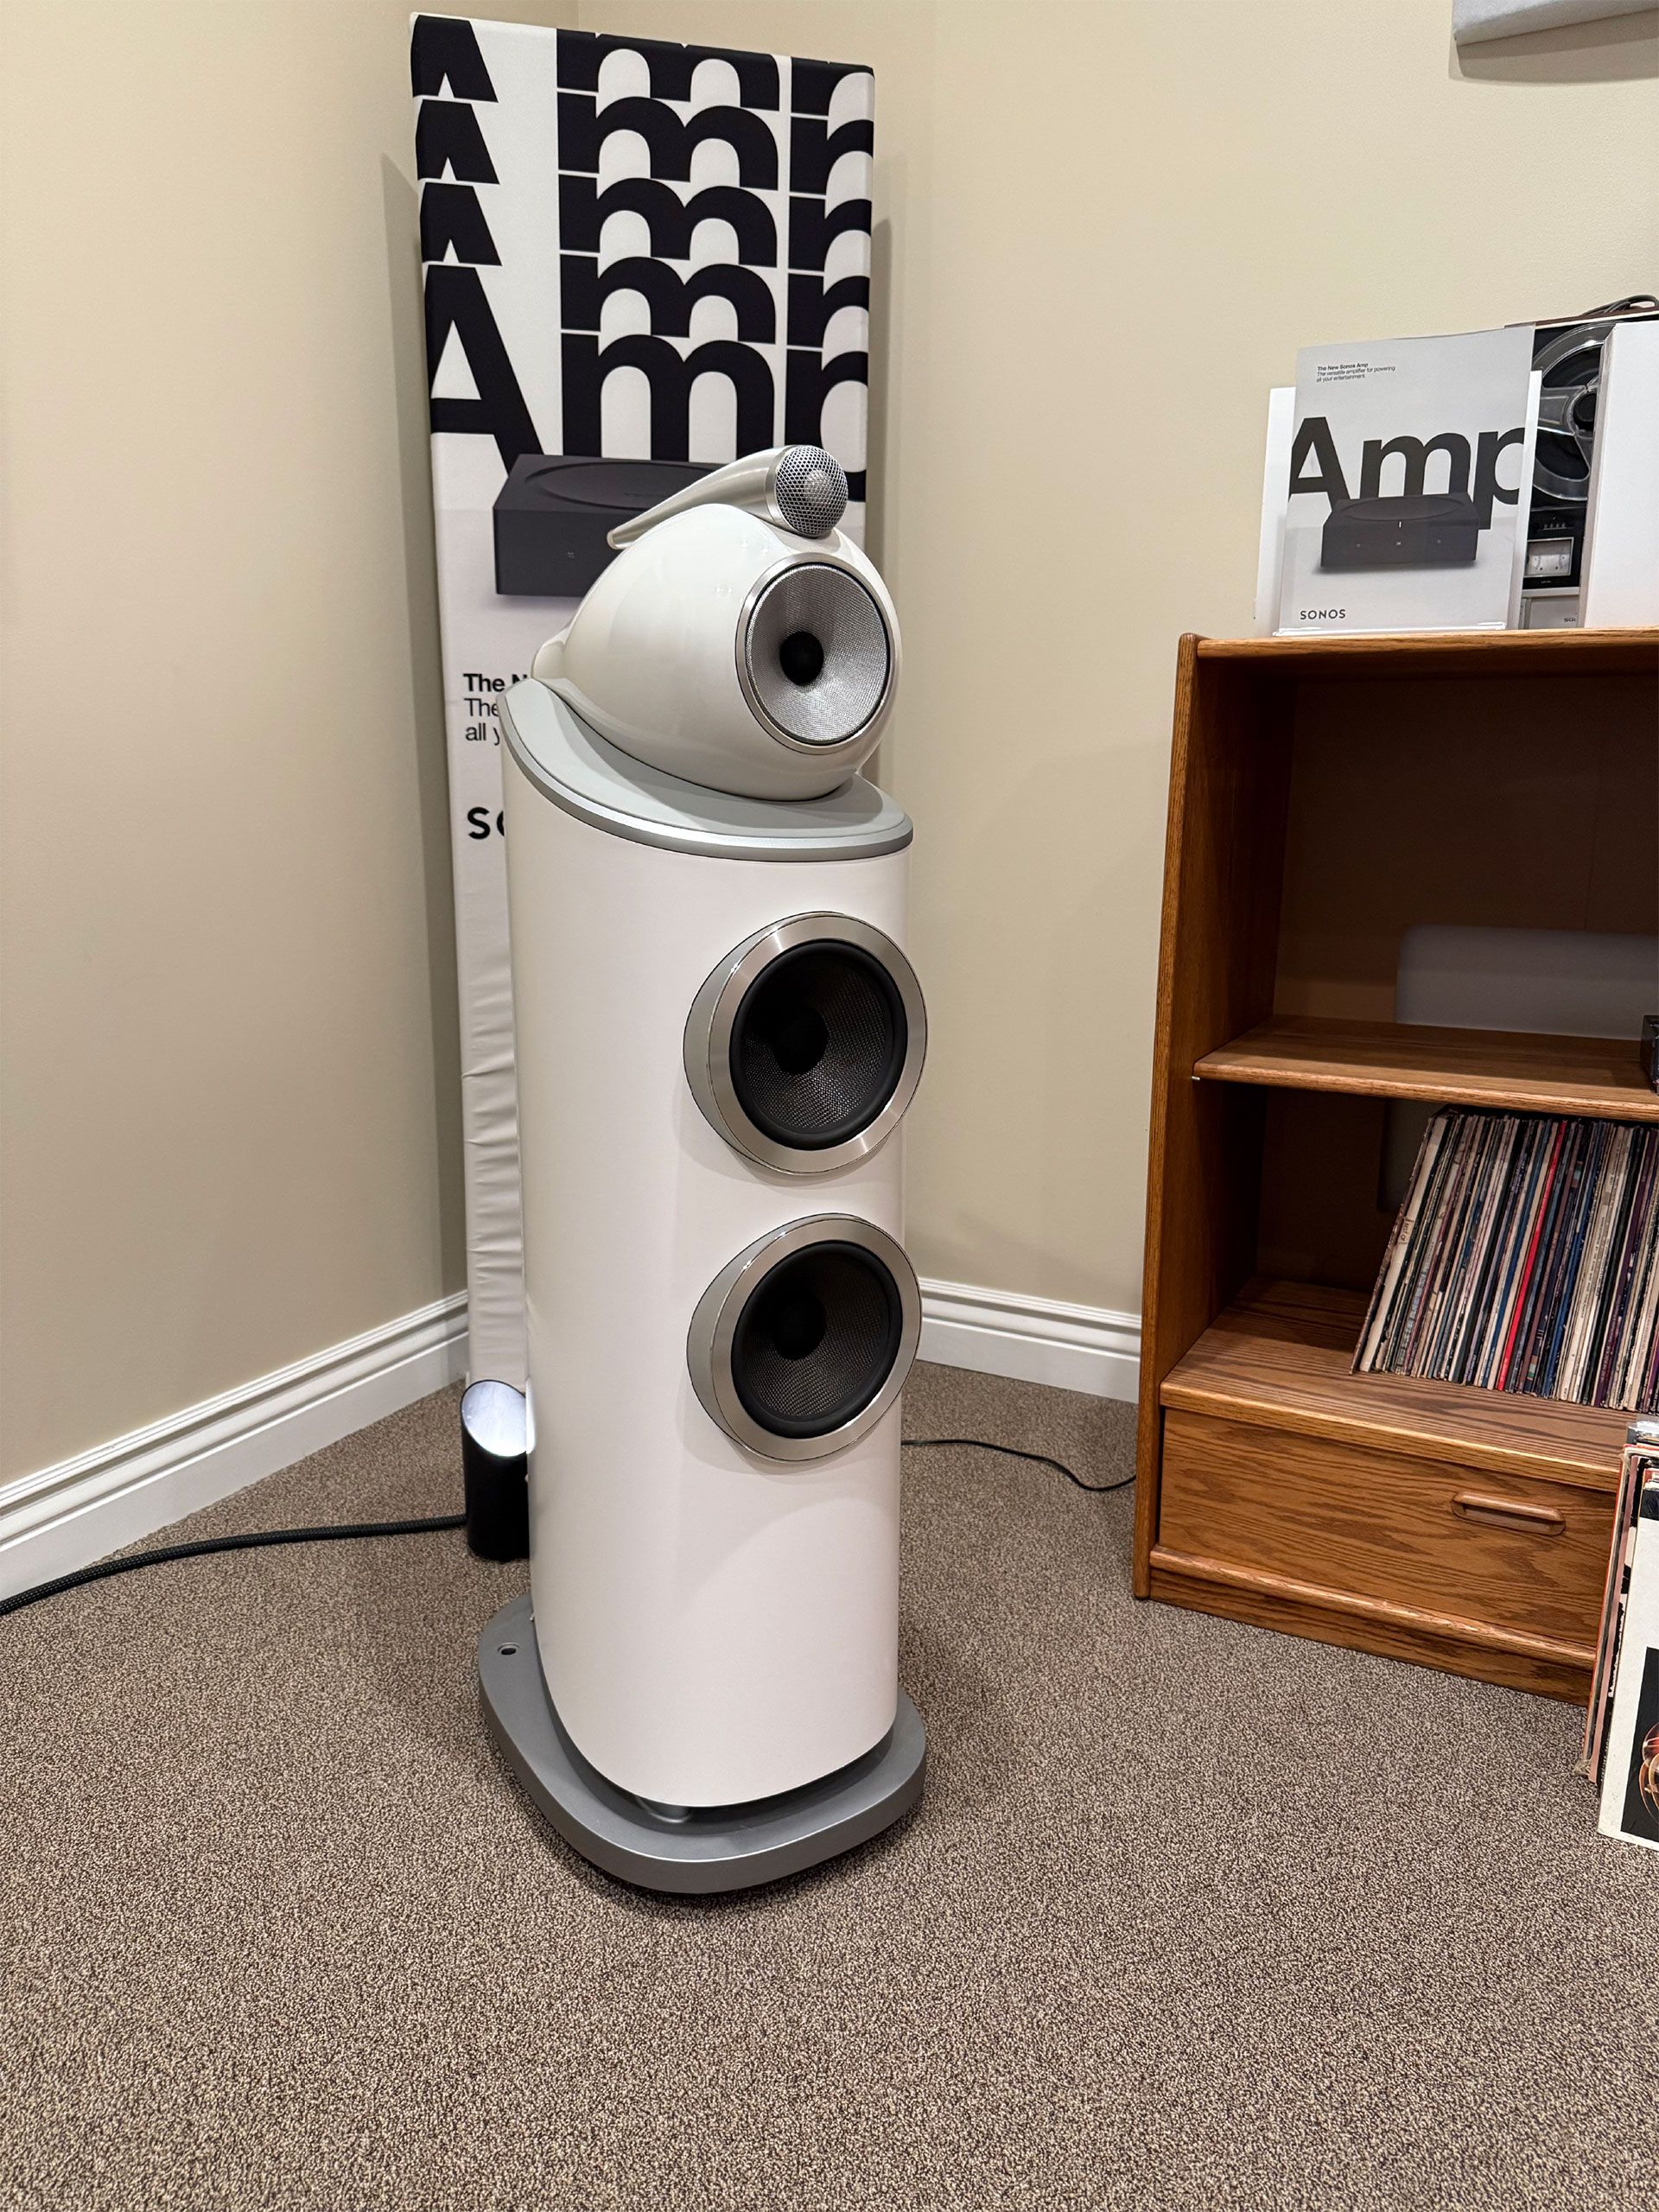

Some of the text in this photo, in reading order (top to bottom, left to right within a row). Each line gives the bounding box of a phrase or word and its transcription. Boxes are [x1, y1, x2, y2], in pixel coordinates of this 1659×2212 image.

[1300, 608, 1346, 620] SONOS
[463, 673, 505, 692] The
[464, 698, 499, 716] The
[466, 722, 486, 741] all
